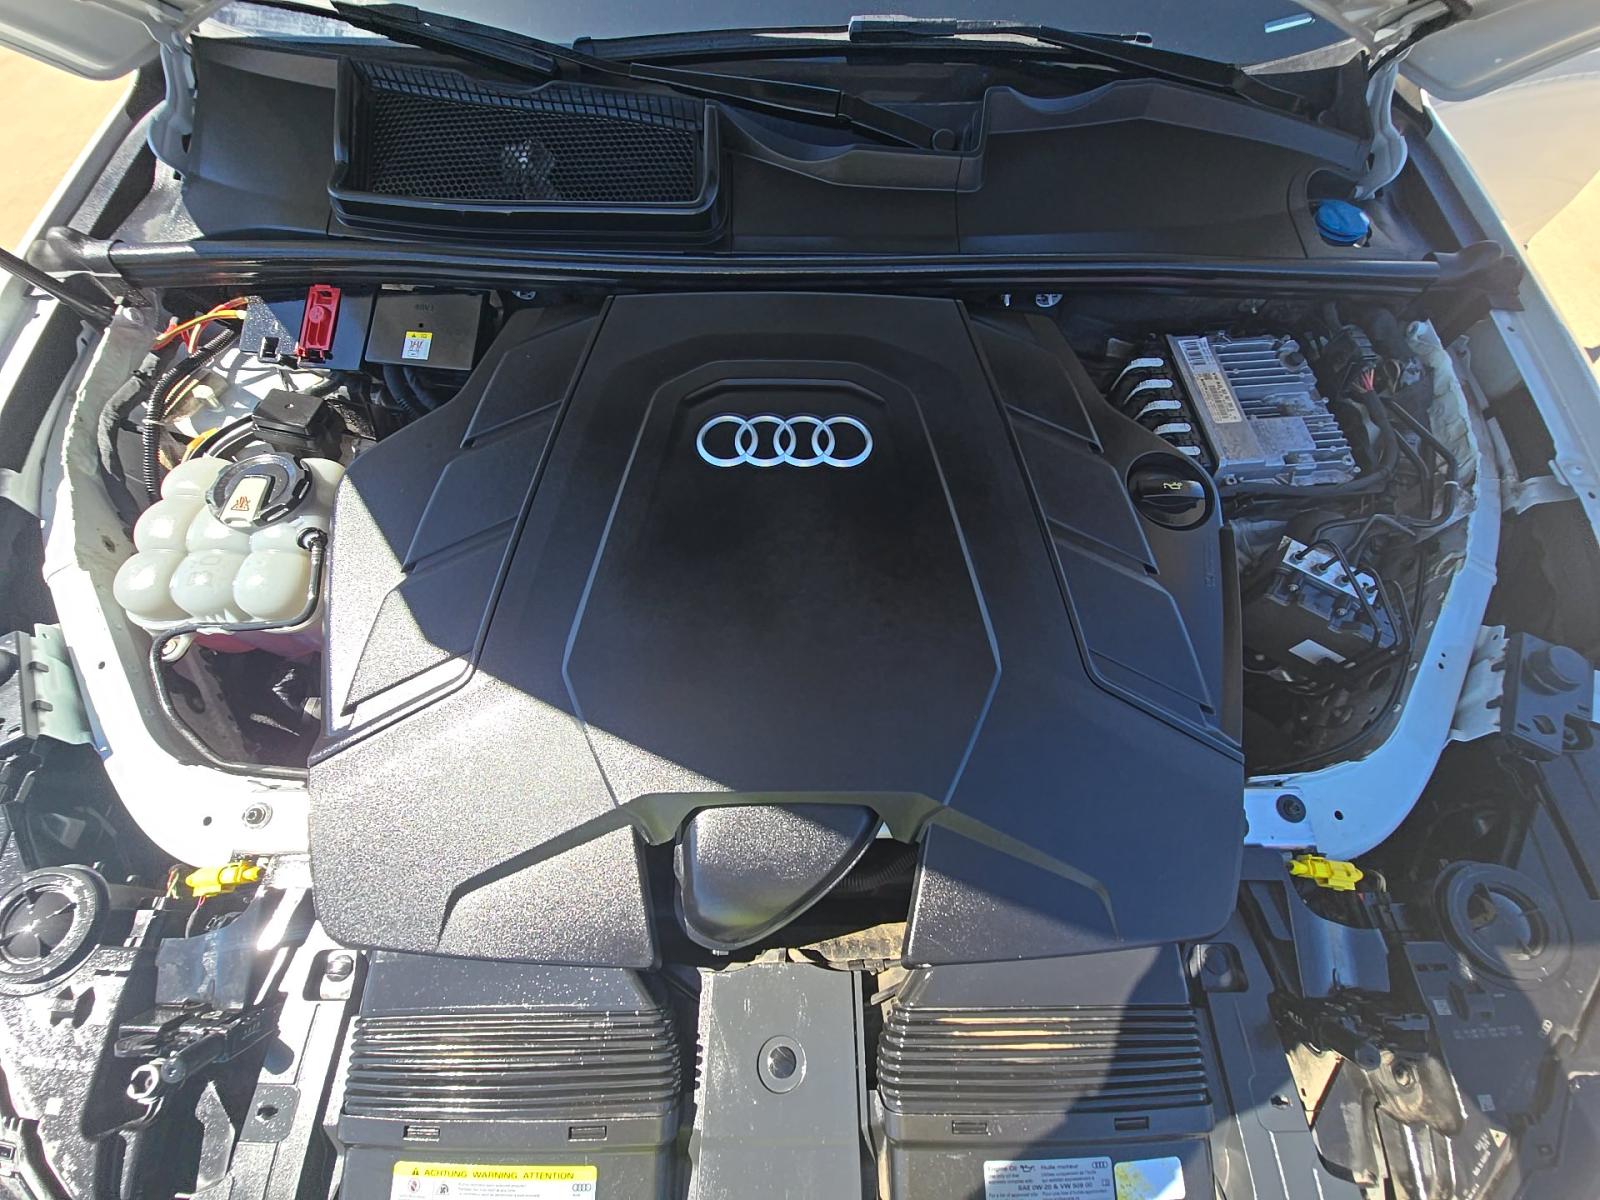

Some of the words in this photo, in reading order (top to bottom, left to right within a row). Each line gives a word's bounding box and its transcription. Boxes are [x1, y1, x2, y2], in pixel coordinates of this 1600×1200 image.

[424, 1169, 467, 1178] ACHTUNG
[472, 1171, 518, 1179] WARNING
[523, 1171, 575, 1180] ATTENTION
